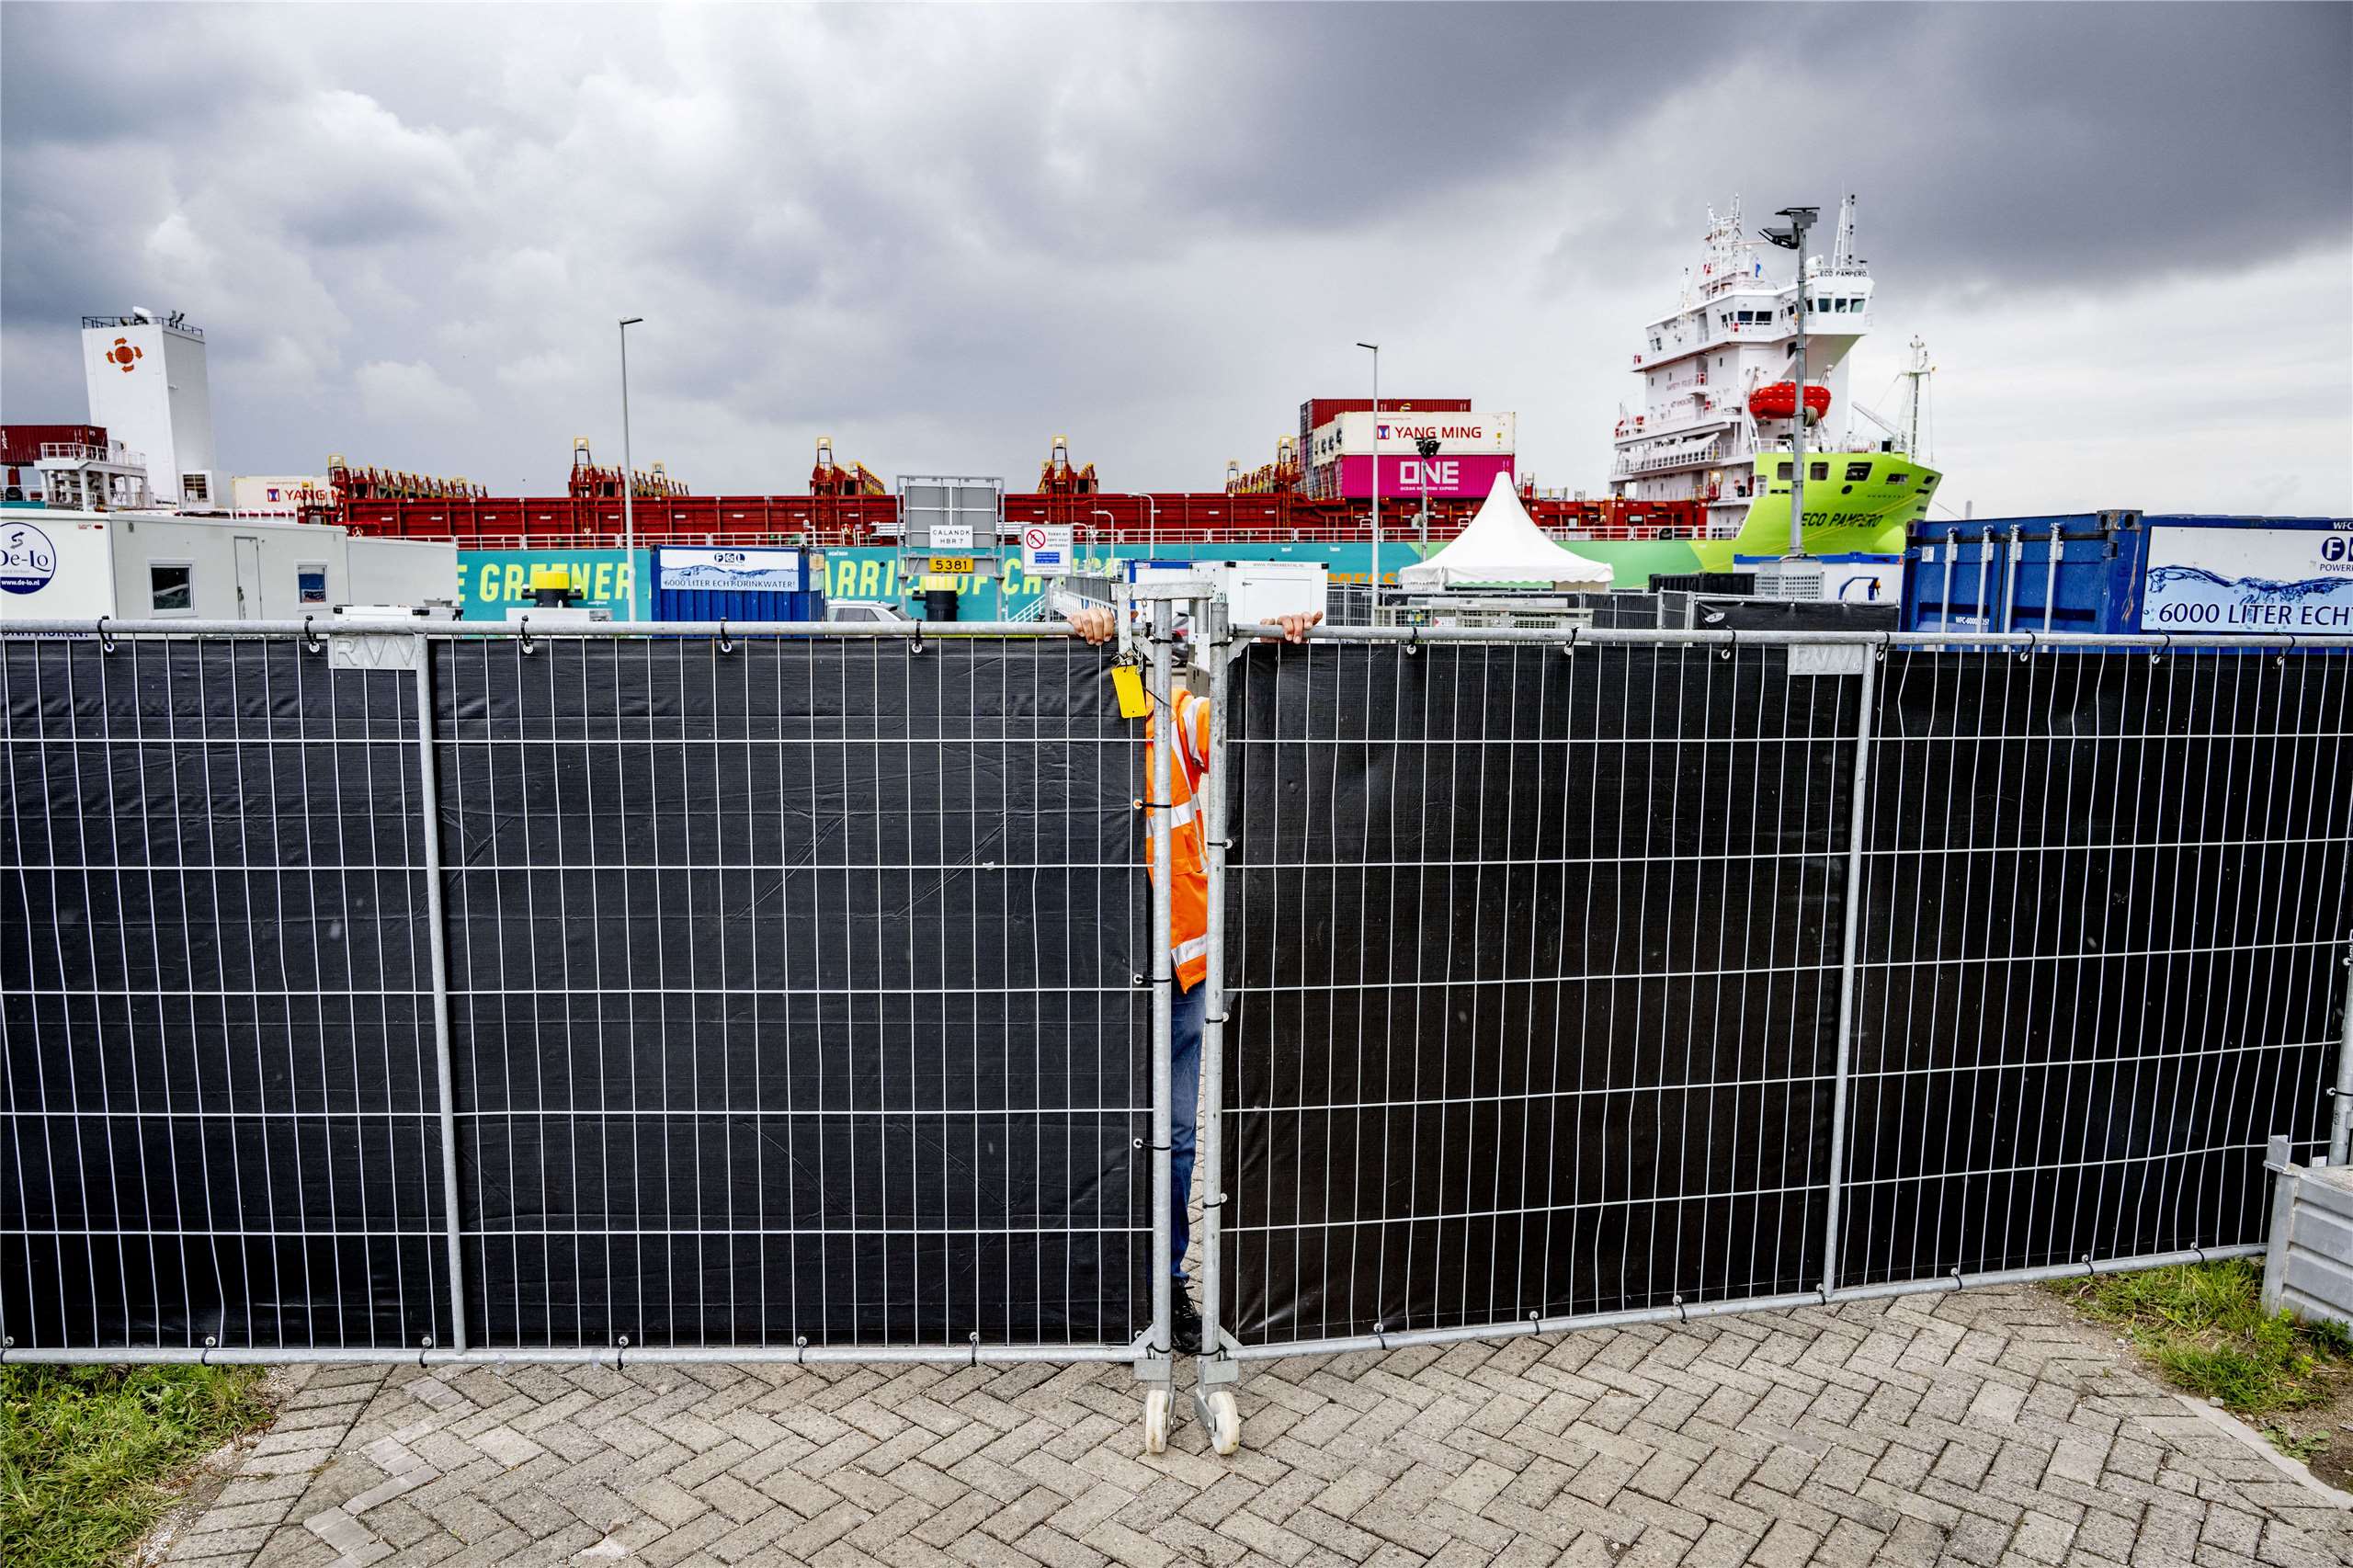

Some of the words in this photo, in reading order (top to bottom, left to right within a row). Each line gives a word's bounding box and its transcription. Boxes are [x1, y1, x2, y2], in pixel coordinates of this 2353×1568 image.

[1395, 426, 1437, 439] YANG
[1441, 426, 1482, 438] MING
[1400, 461, 1460, 484] ONE
[1801, 513, 1828, 527] ECO
[936, 560, 967, 571] 5381
[2319, 563, 2353, 572] POWER
[479, 562, 631, 602] GRNER
[665, 579, 686, 587] 6000
[2159, 603, 2220, 623] 6000
[2228, 604, 2292, 625] LITER
[2301, 606, 2353, 626] ECH
